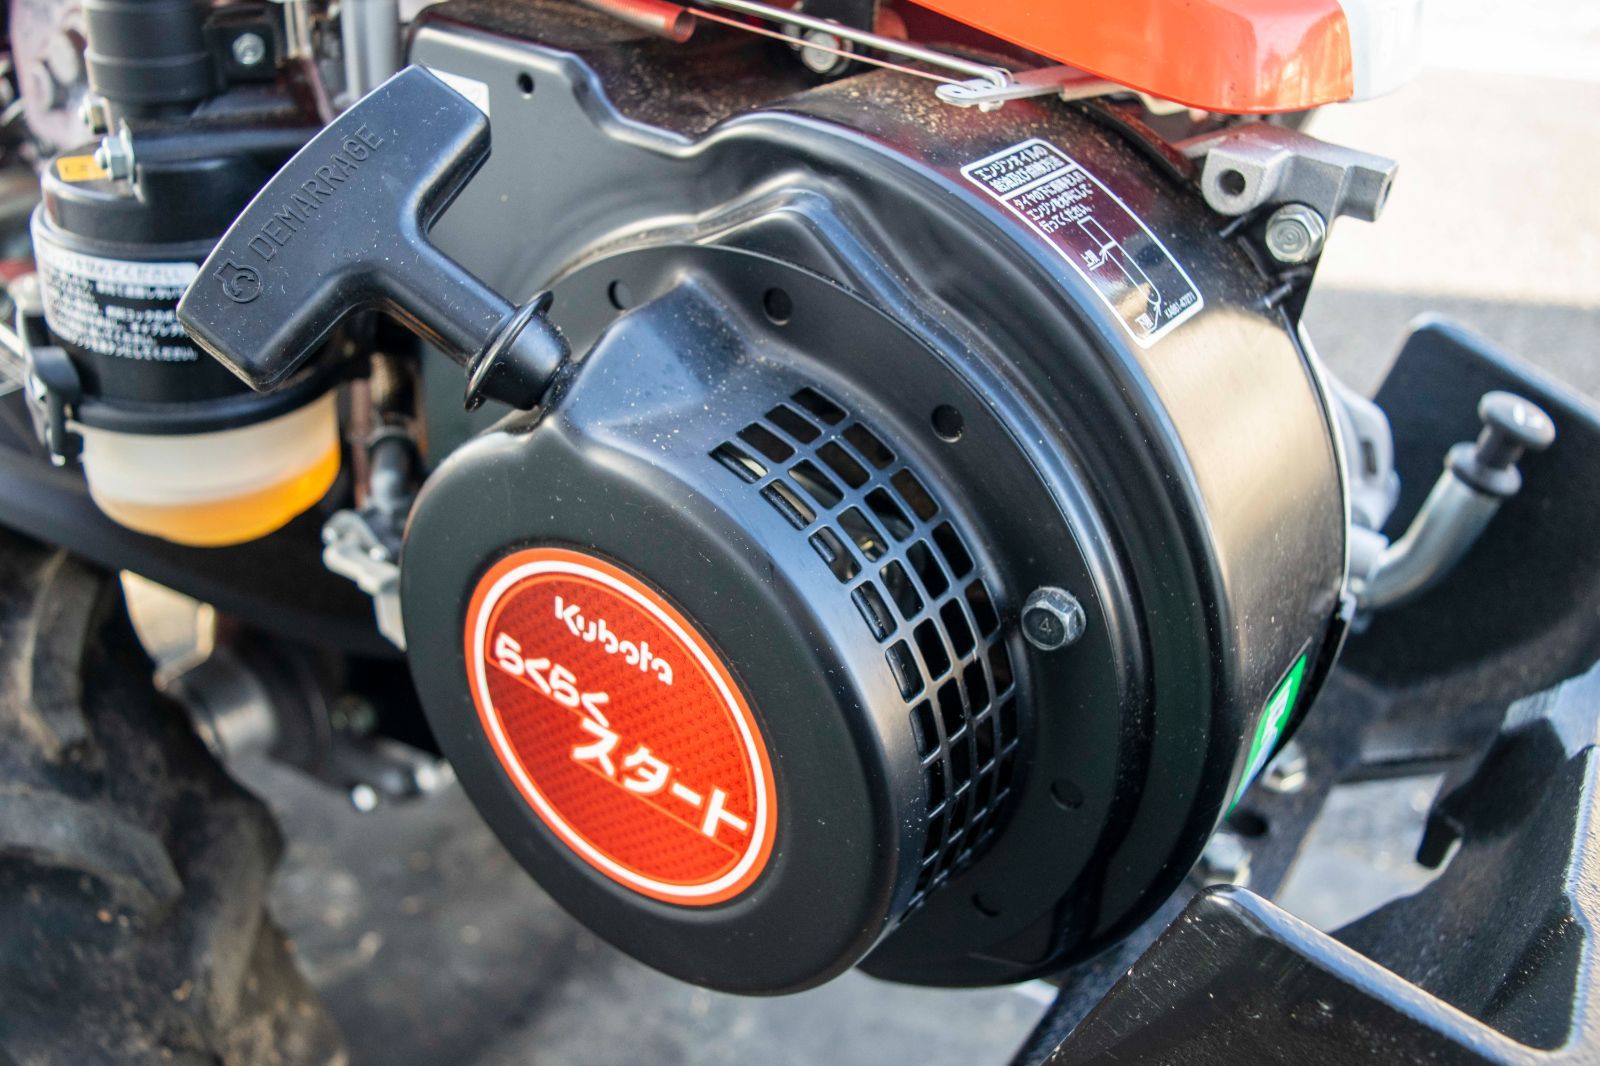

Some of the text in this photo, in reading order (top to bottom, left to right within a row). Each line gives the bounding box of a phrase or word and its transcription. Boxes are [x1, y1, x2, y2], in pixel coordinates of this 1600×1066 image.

[248, 123, 384, 262] DEMARRAGE
[495, 632, 609, 728] らくらく
[554, 596, 673, 686] Kubota
[571, 716, 748, 837] スタート
